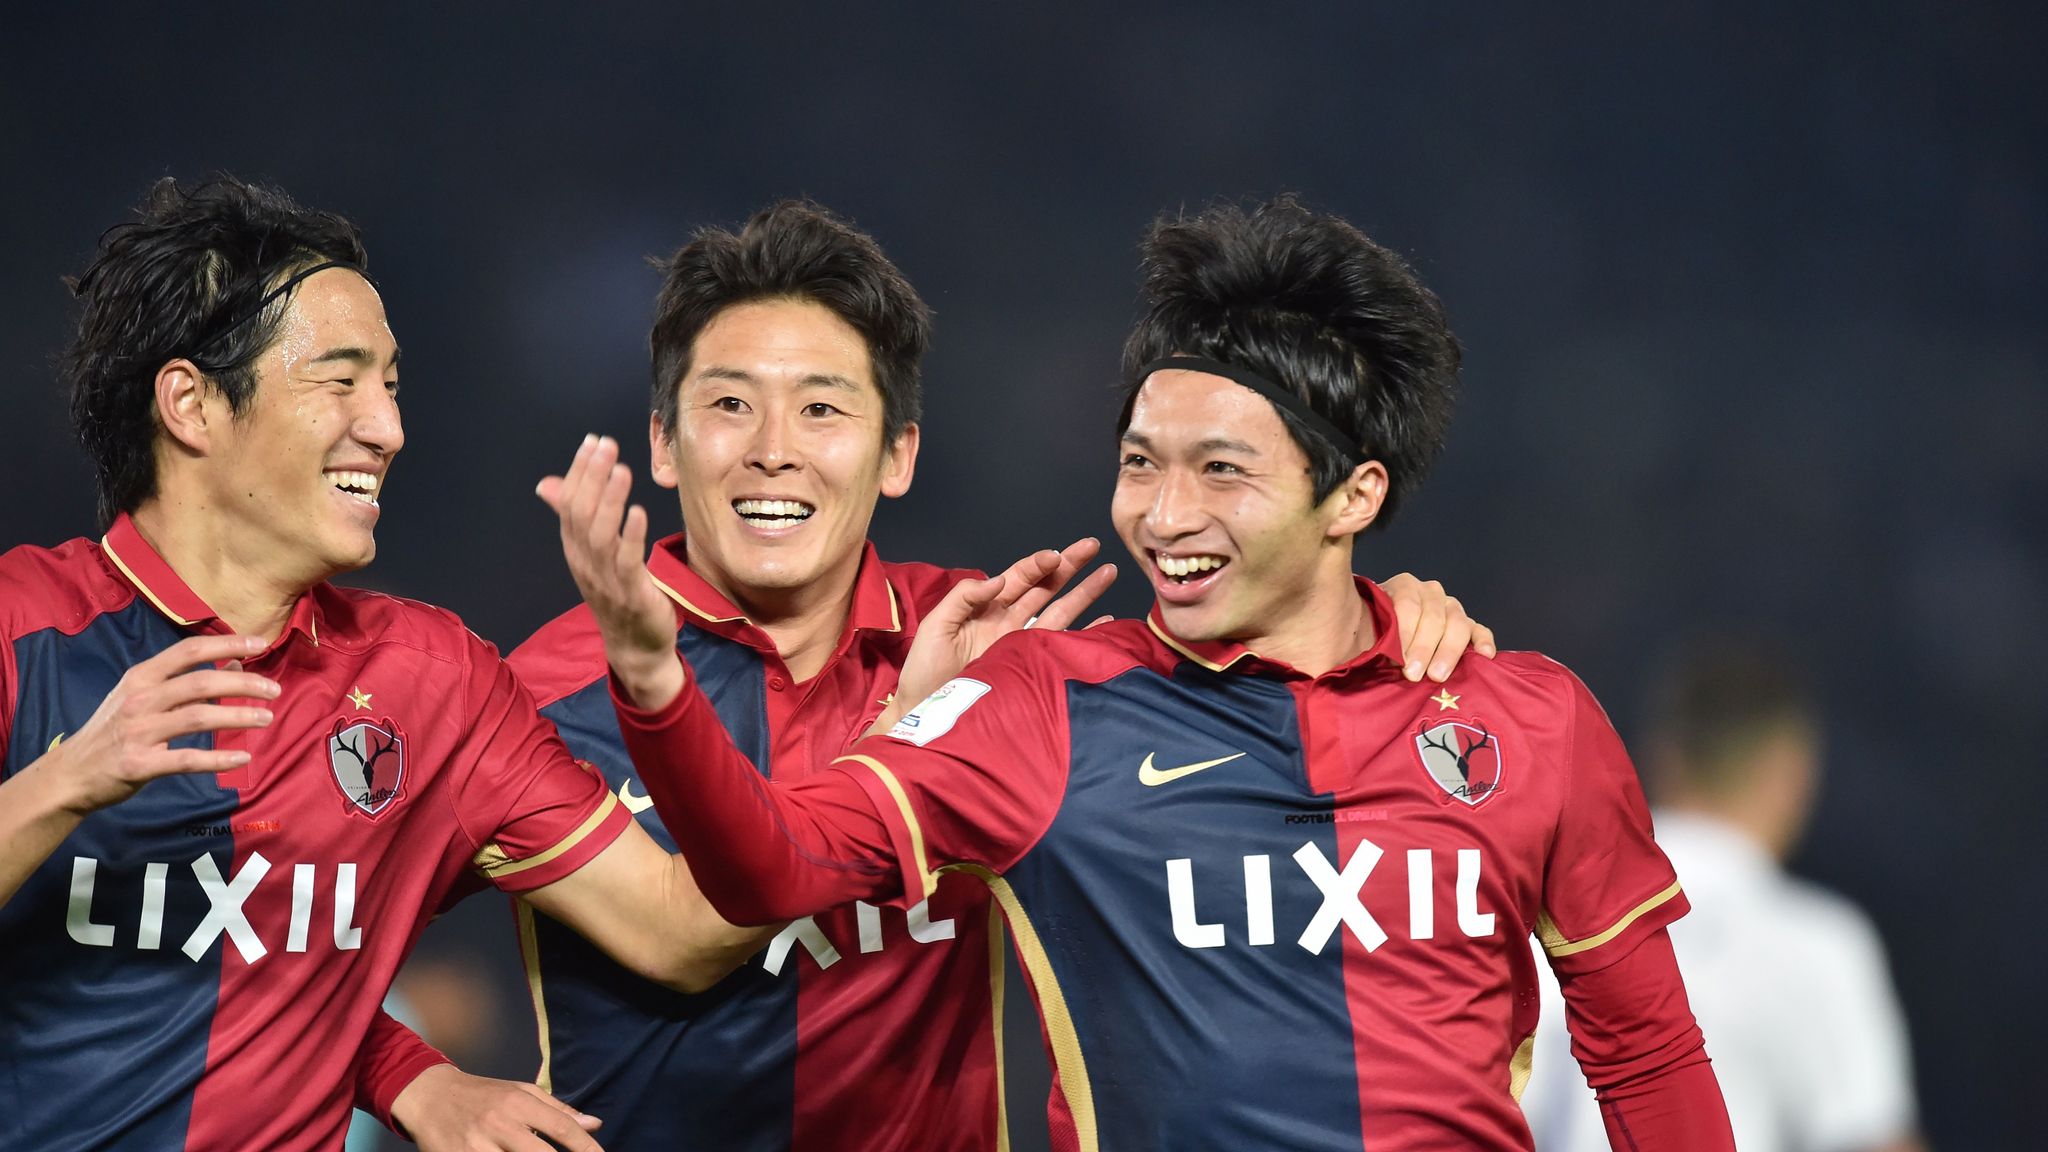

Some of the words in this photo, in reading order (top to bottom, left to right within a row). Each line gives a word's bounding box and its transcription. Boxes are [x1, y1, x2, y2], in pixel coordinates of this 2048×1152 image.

[185, 824, 241, 837] FOOTBALL
[1285, 811, 1346, 824] FOOTBALL
[66, 851, 362, 965] LIXIL
[1166, 838, 1496, 956] LIXIL
